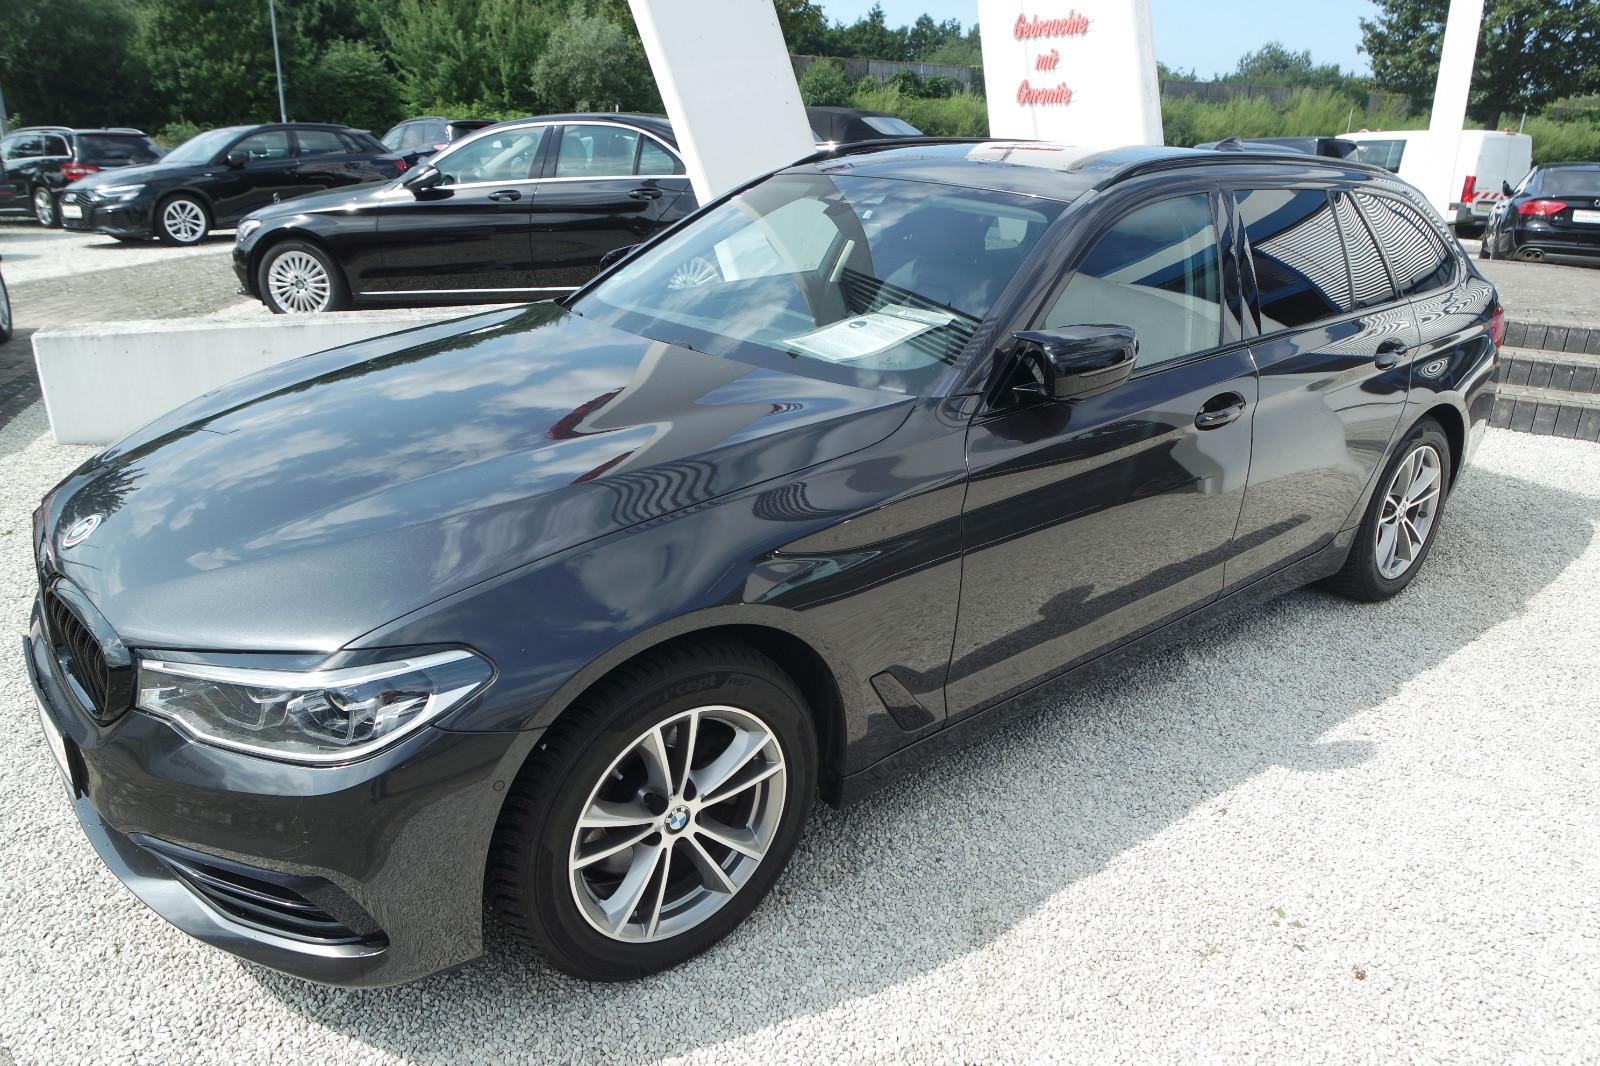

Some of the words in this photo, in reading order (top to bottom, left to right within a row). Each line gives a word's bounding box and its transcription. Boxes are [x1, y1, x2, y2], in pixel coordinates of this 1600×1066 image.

[1014, 10, 1089, 40] Gebrauchte
[1035, 48, 1060, 71] mit
[1016, 79, 1073, 106] Garantie
